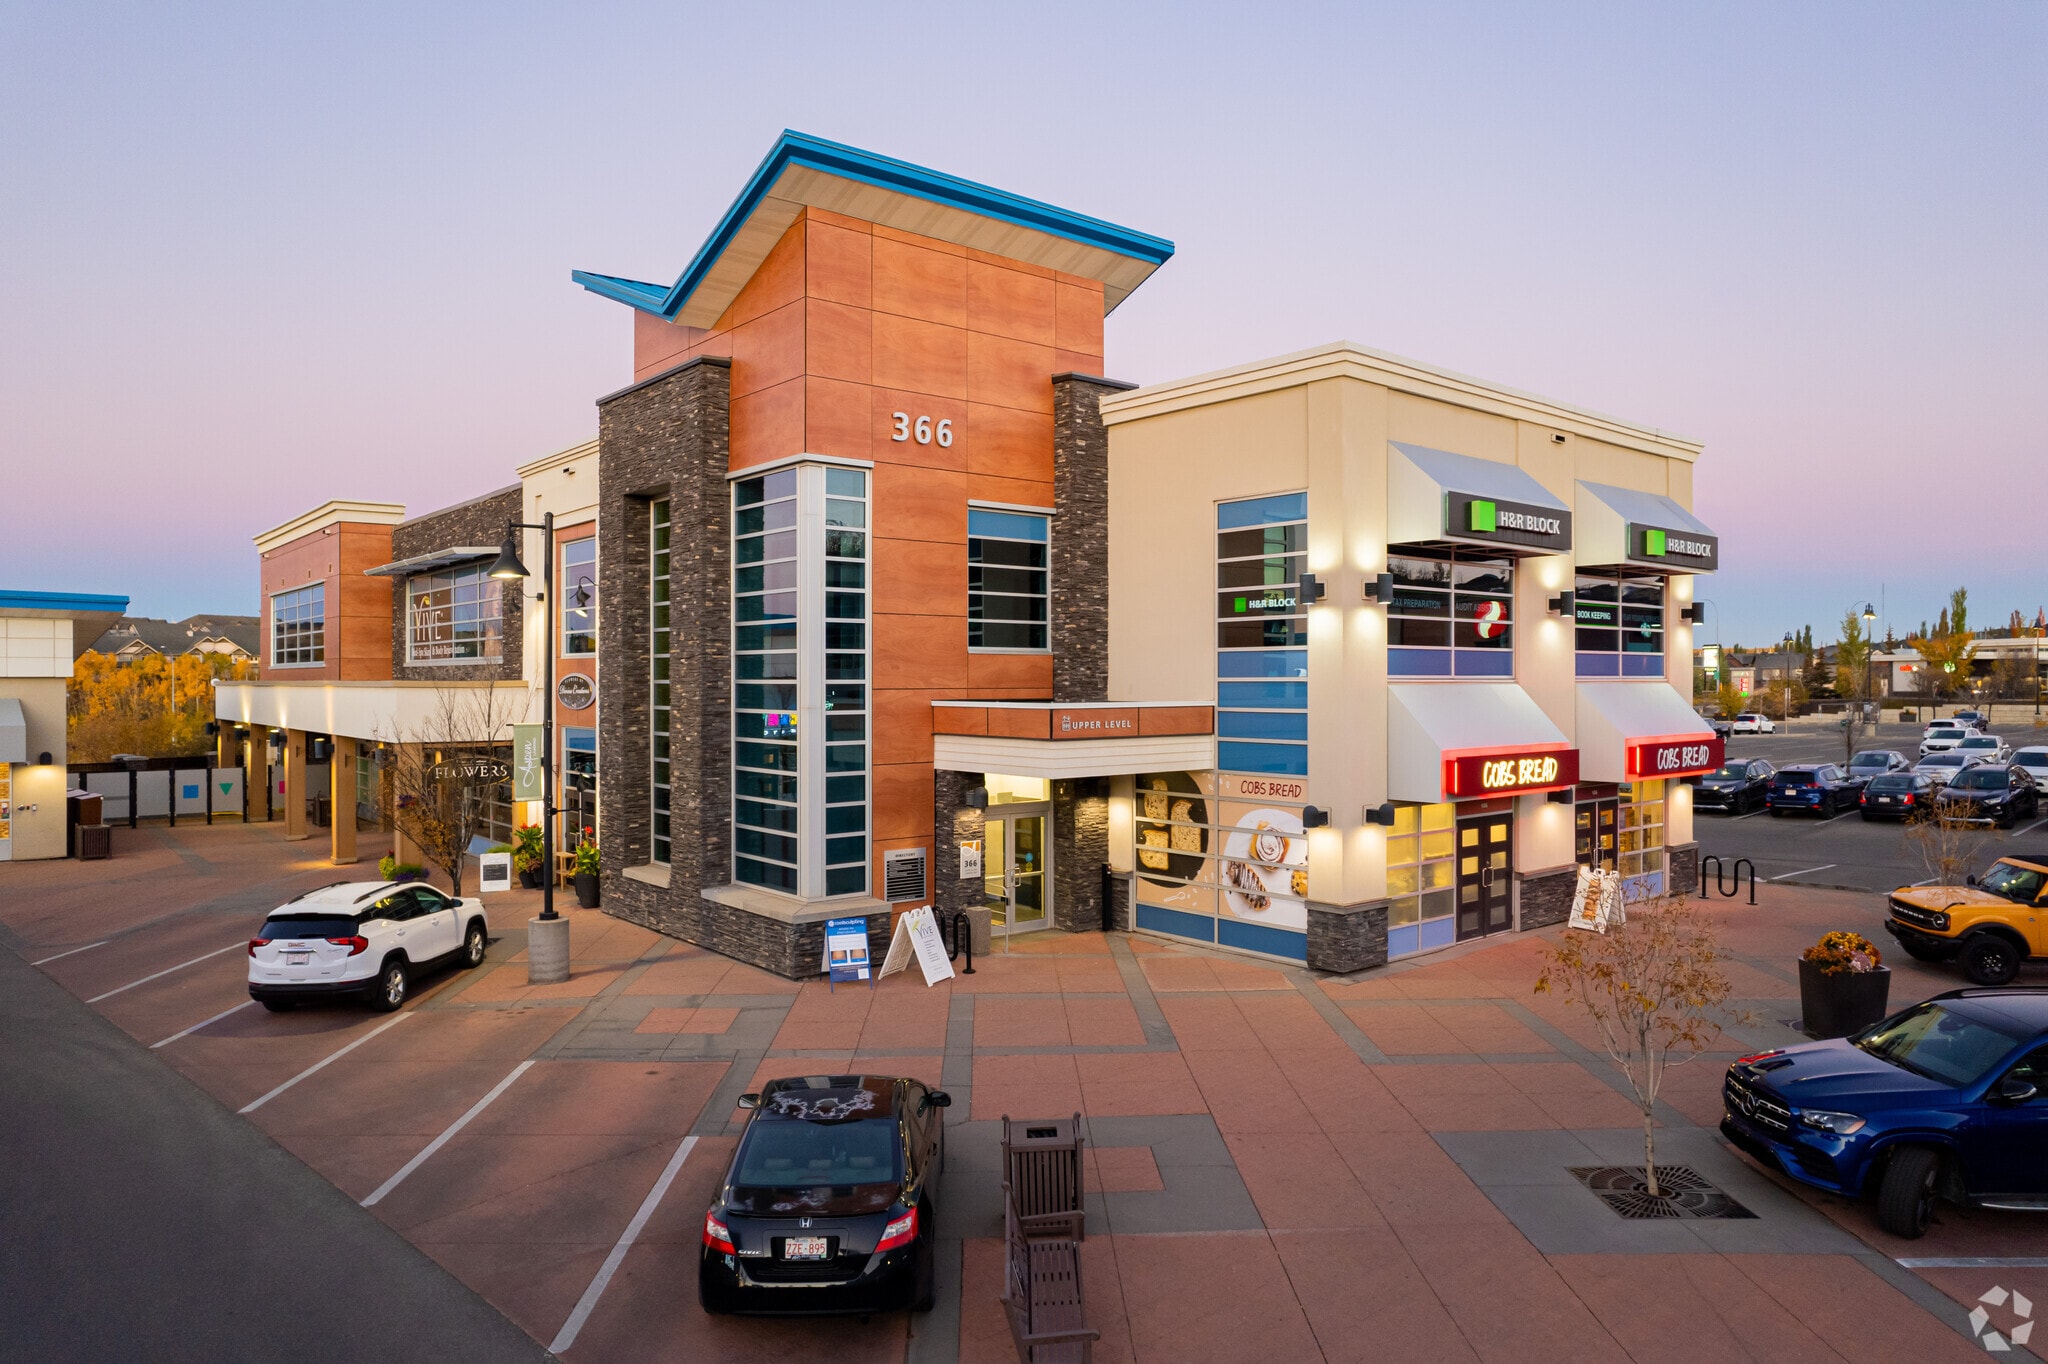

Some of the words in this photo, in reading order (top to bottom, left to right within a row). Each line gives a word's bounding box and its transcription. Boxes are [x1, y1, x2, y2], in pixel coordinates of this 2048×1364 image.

[891, 411, 953, 448] 366
[1500, 511, 1525, 530] H&R
[1526, 515, 1561, 535] BLOCK
[1668, 538, 1686, 553] H&R
[1687, 541, 1712, 558] BLOCK
[1248, 599, 1267, 609] H&R
[1268, 597, 1297, 608] BLOCK
[1392, 598, 1403, 607] TAX
[1403, 599, 1441, 609] PREPARATION
[1455, 602, 1473, 612] AUDIT
[1576, 610, 1591, 619] BOOK
[1591, 611, 1612, 620] KEEPING
[1072, 721, 1101, 730] UPPER
[1105, 720, 1132, 729] LEVEL
[519, 740, 538, 787] Aspen
[1657, 747, 1680, 770] COBS
[1681, 744, 1710, 767] BREAD
[435, 764, 508, 779] FLOWERS
[1483, 761, 1516, 788] COBS
[1518, 756, 1558, 784] BREAD
[1240, 780, 1267, 795] COBS
[1268, 782, 1302, 798] BREAD
[964, 860, 977, 868] 366
